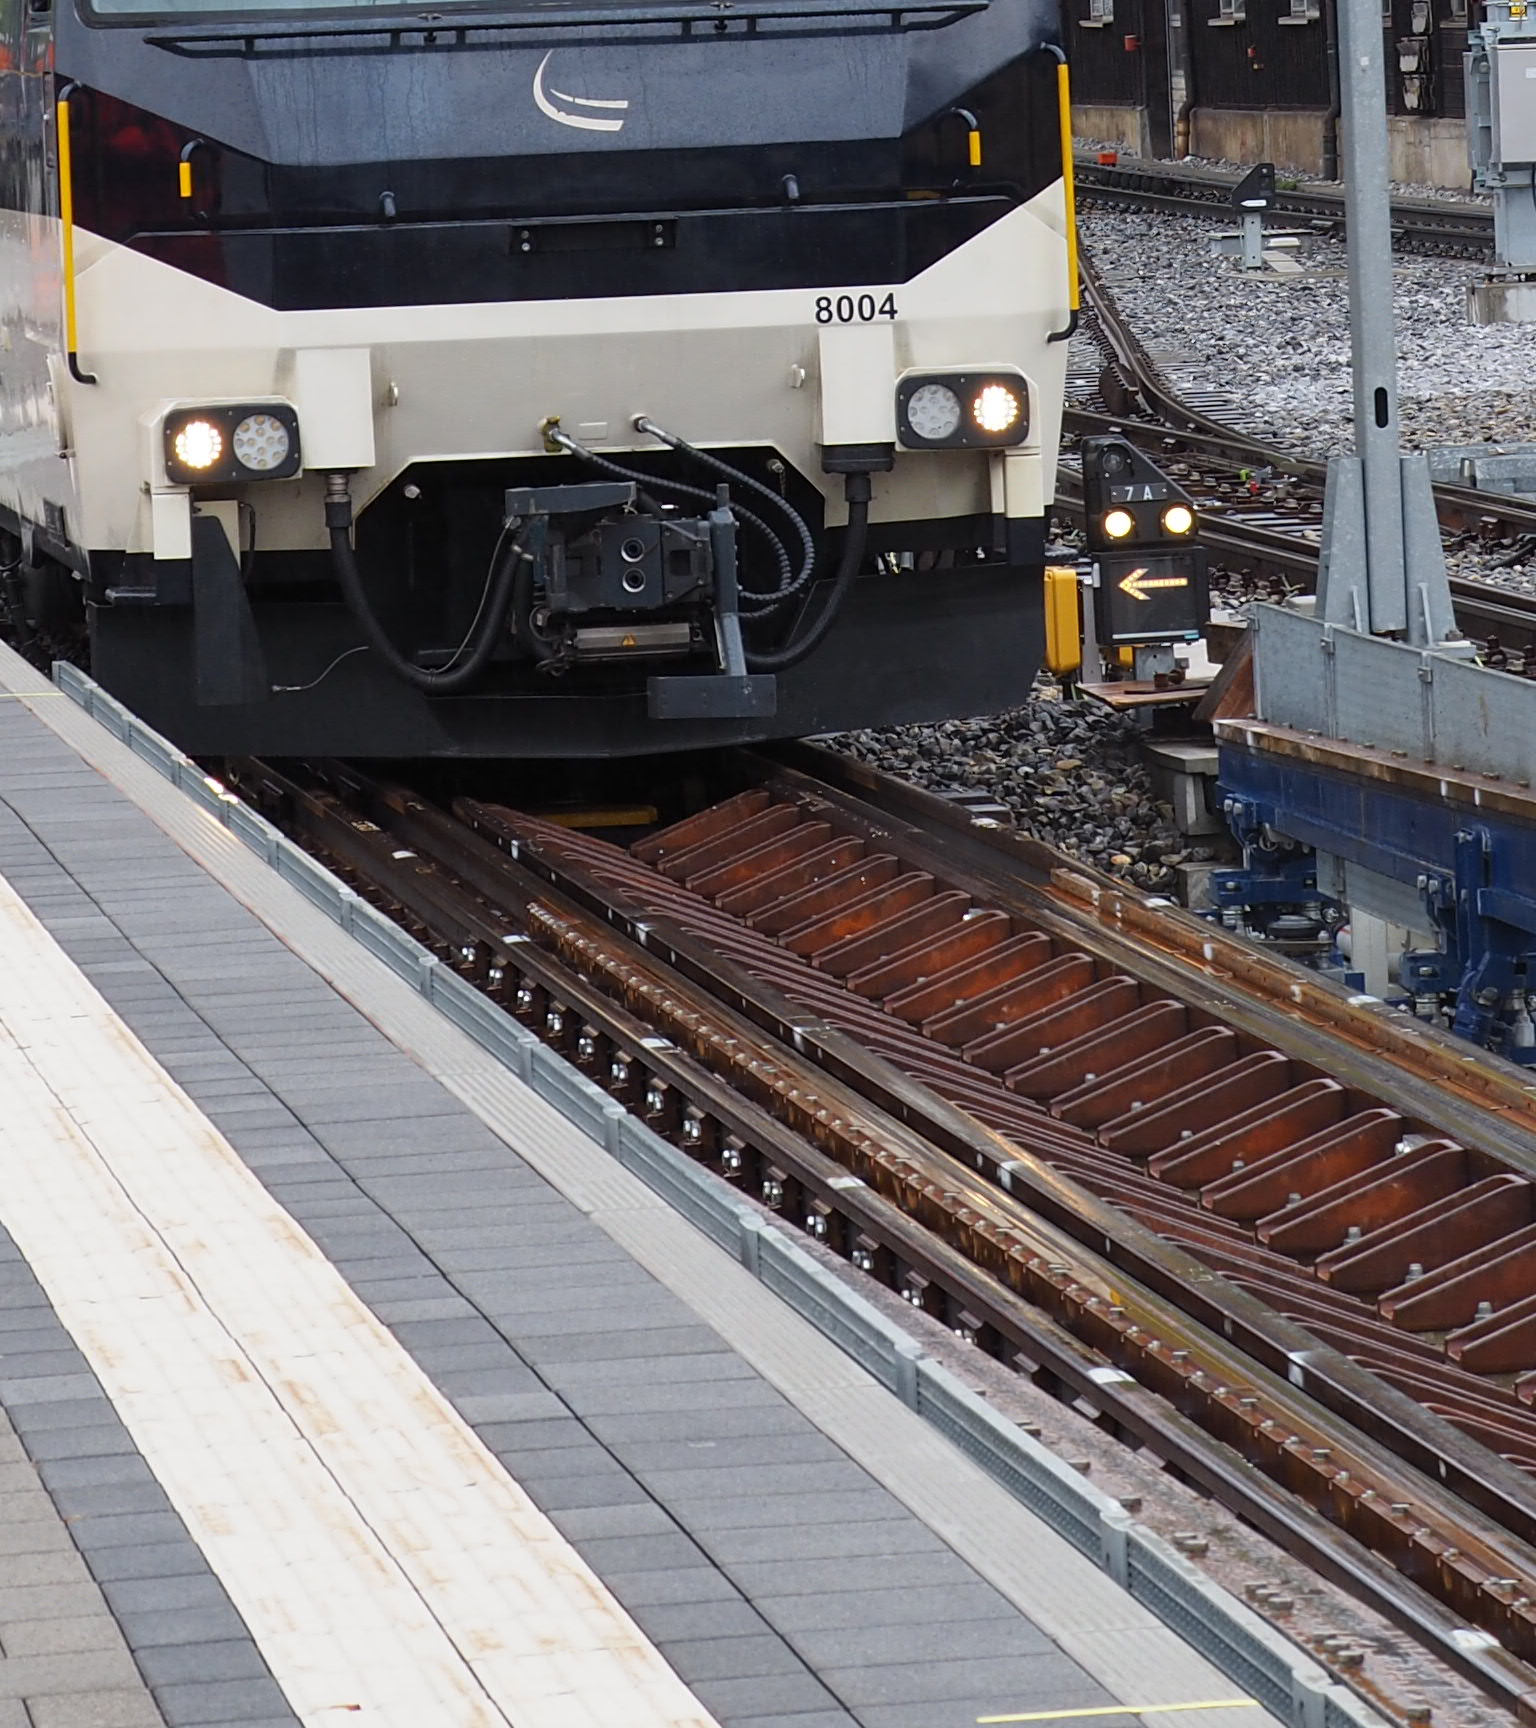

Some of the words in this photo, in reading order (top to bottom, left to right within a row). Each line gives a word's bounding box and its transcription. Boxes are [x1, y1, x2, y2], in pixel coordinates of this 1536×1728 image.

[815, 292, 899, 324] 8004
[1124, 486, 1134, 501] 7
[1143, 484, 1153, 500] A
